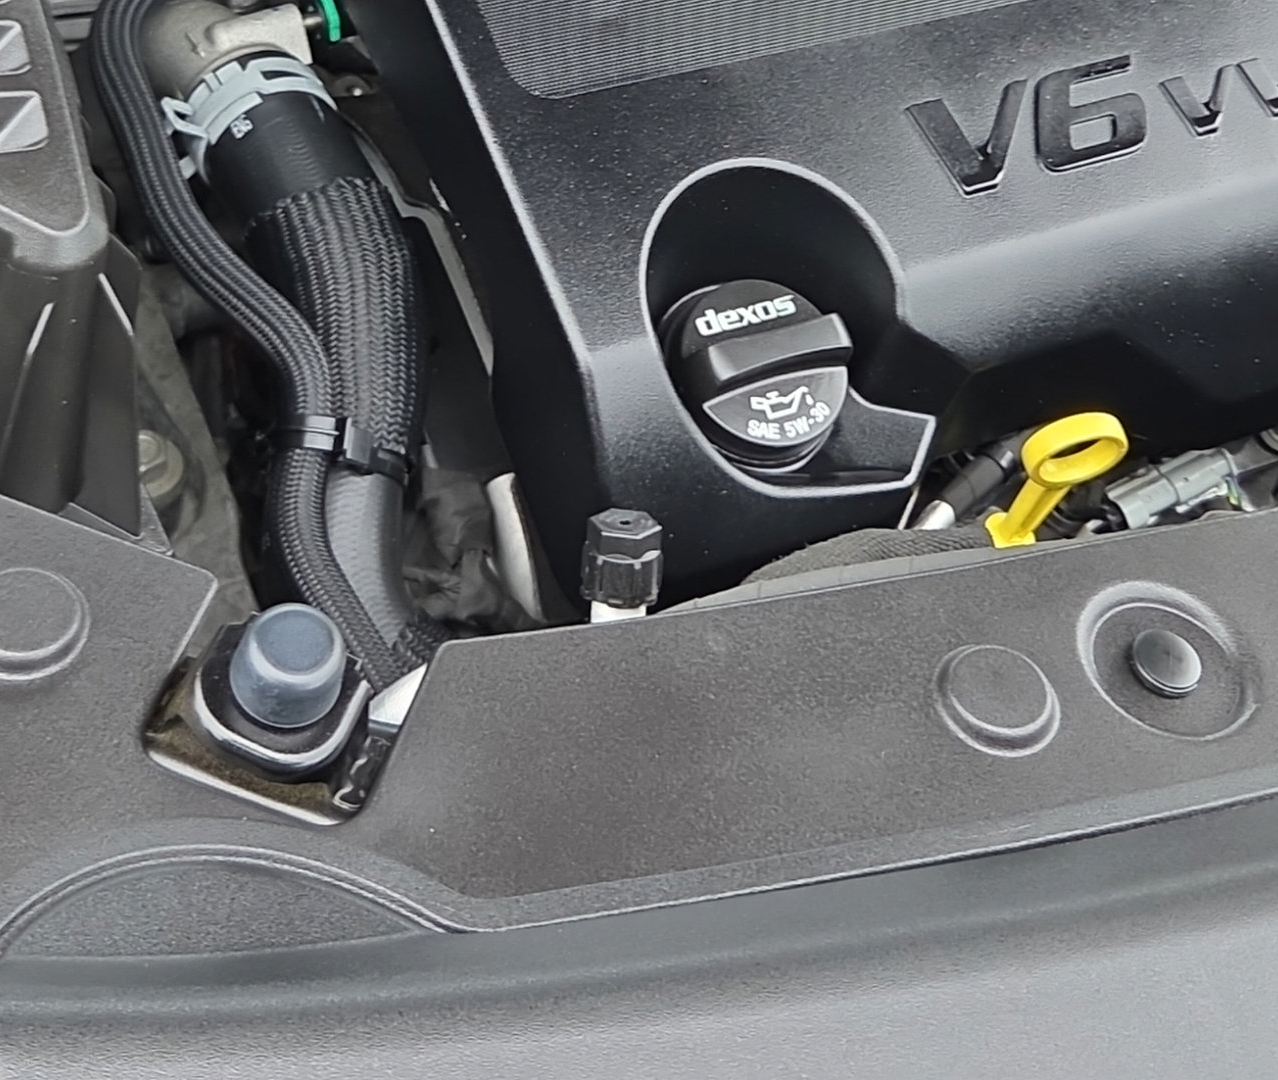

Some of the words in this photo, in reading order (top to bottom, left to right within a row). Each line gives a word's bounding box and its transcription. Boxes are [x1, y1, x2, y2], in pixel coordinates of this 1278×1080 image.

[904, 54, 1147, 198] V6
[694, 294, 797, 337] dexos
[747, 419, 781, 440] SAE
[783, 401, 831, 438] 5W-30
